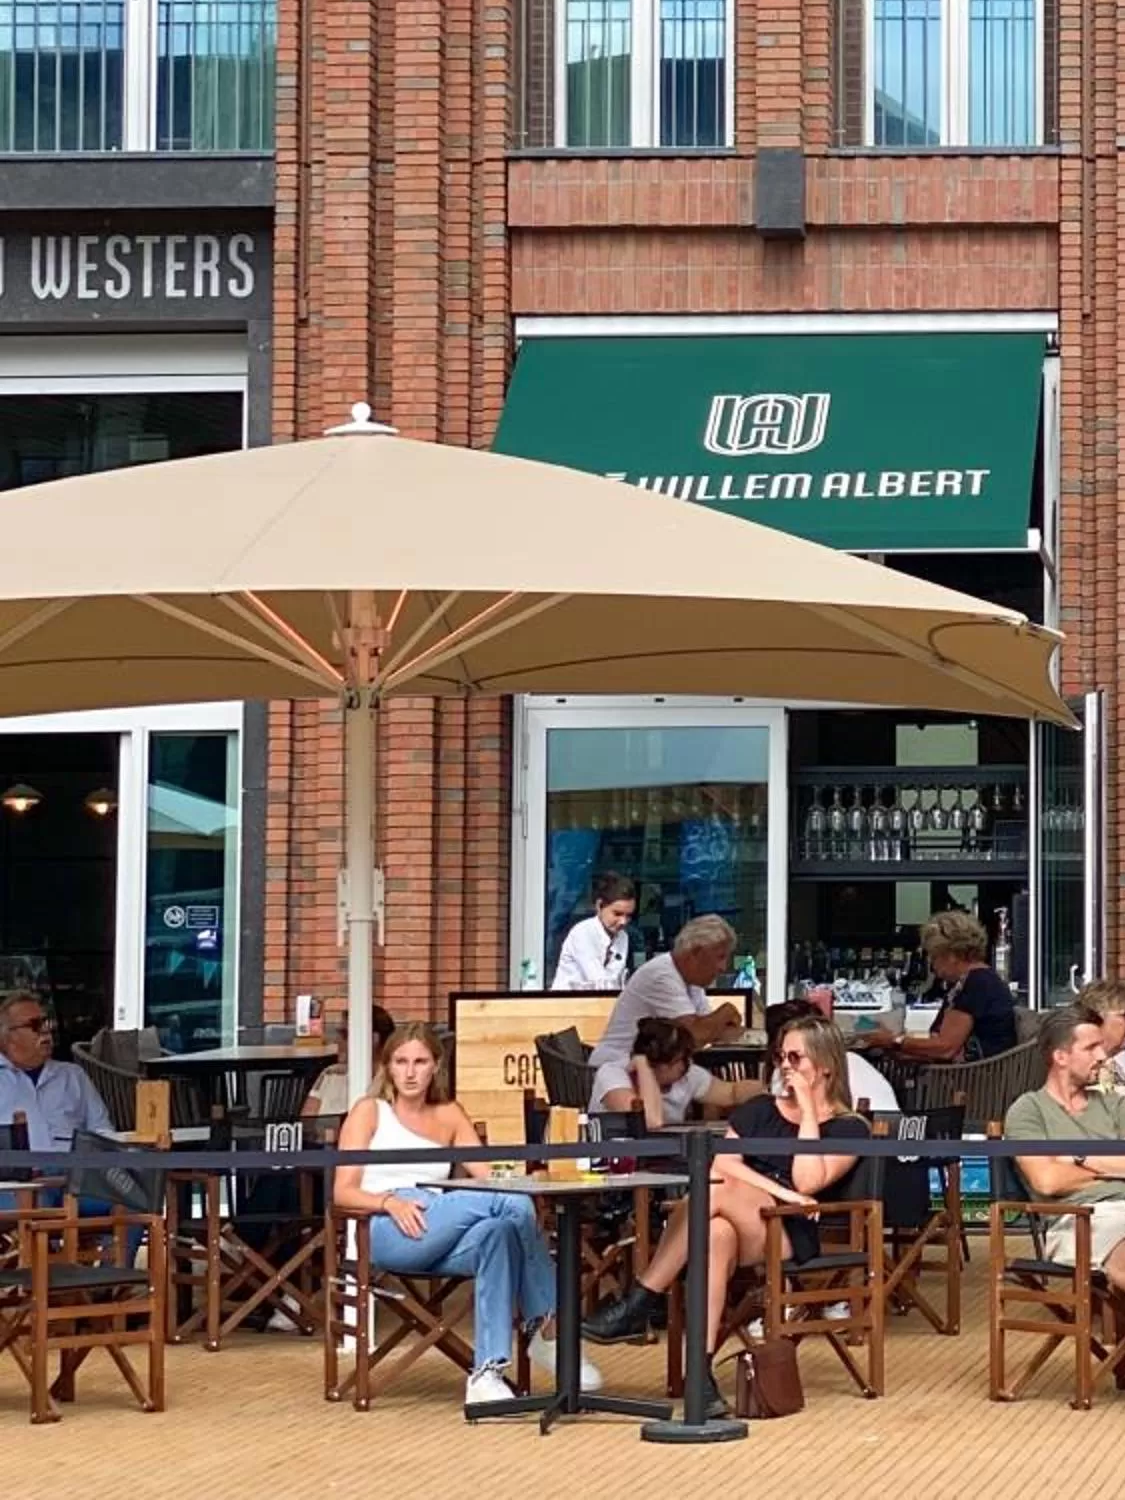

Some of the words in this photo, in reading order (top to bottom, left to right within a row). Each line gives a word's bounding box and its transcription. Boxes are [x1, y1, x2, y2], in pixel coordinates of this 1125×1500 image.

[31, 234, 255, 299] WESTERS
[821, 469, 991, 499] ALBERT
[504, 1053, 541, 1086] CAF
